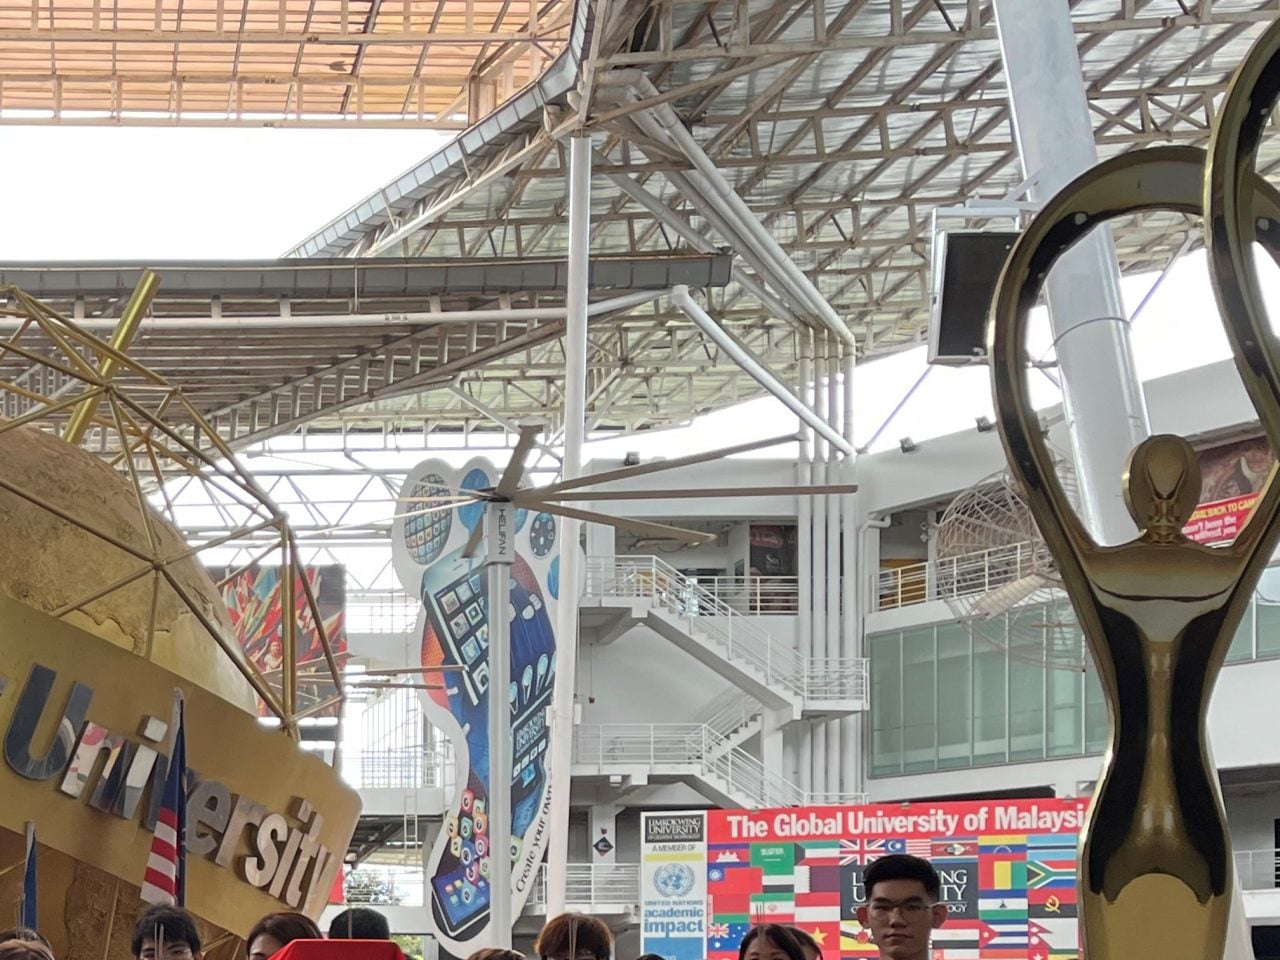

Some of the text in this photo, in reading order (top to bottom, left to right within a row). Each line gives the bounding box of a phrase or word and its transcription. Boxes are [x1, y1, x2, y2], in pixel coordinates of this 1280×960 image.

[498, 508, 507, 555] HELIFAN
[4, 662, 336, 922] Uniersity
[648, 825, 701, 836] UNIVERSITY
[727, 803, 1084, 839] The Global University of Malaysi
[516, 850, 535, 893] Create
[532, 816, 546, 848] your
[658, 844, 687, 852] MEMBER
[644, 907, 704, 918] academic
[644, 919, 704, 938] impact
